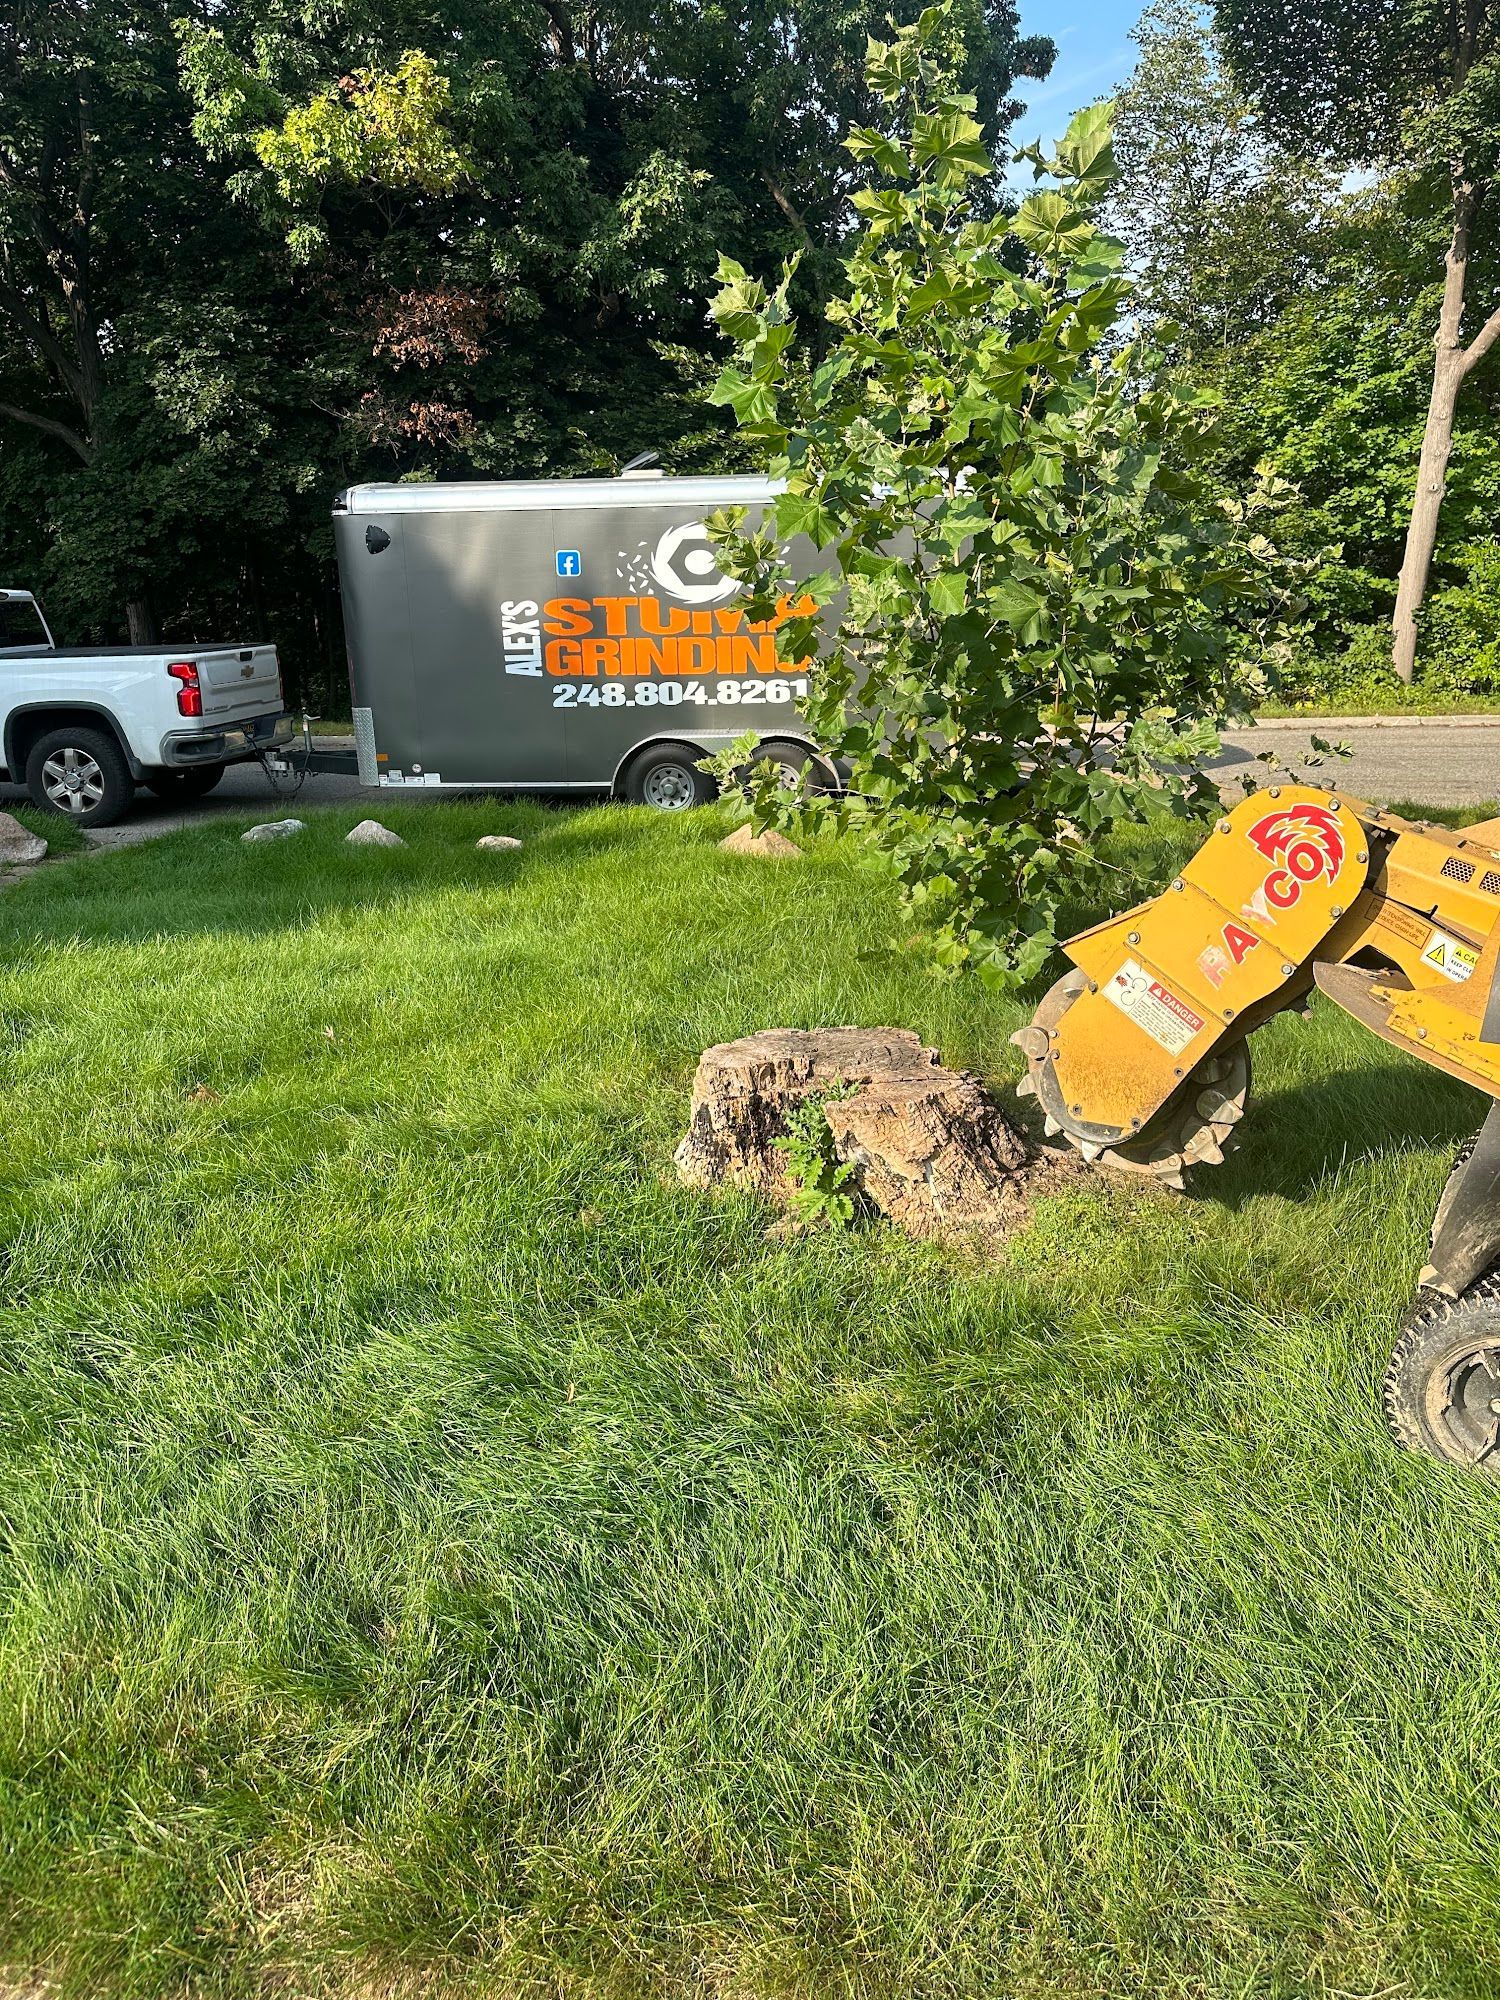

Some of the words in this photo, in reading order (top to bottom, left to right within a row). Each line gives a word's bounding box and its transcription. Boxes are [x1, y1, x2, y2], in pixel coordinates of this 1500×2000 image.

[500, 600, 543, 677] ALEX'S
[545, 634, 813, 676] GRINDIN
[553, 679, 807, 707] 248.804.8261
[1196, 840, 1325, 991] RAYCO
[1450, 958, 1462, 968] KEEP
[1161, 993, 1200, 1027] DANGER
